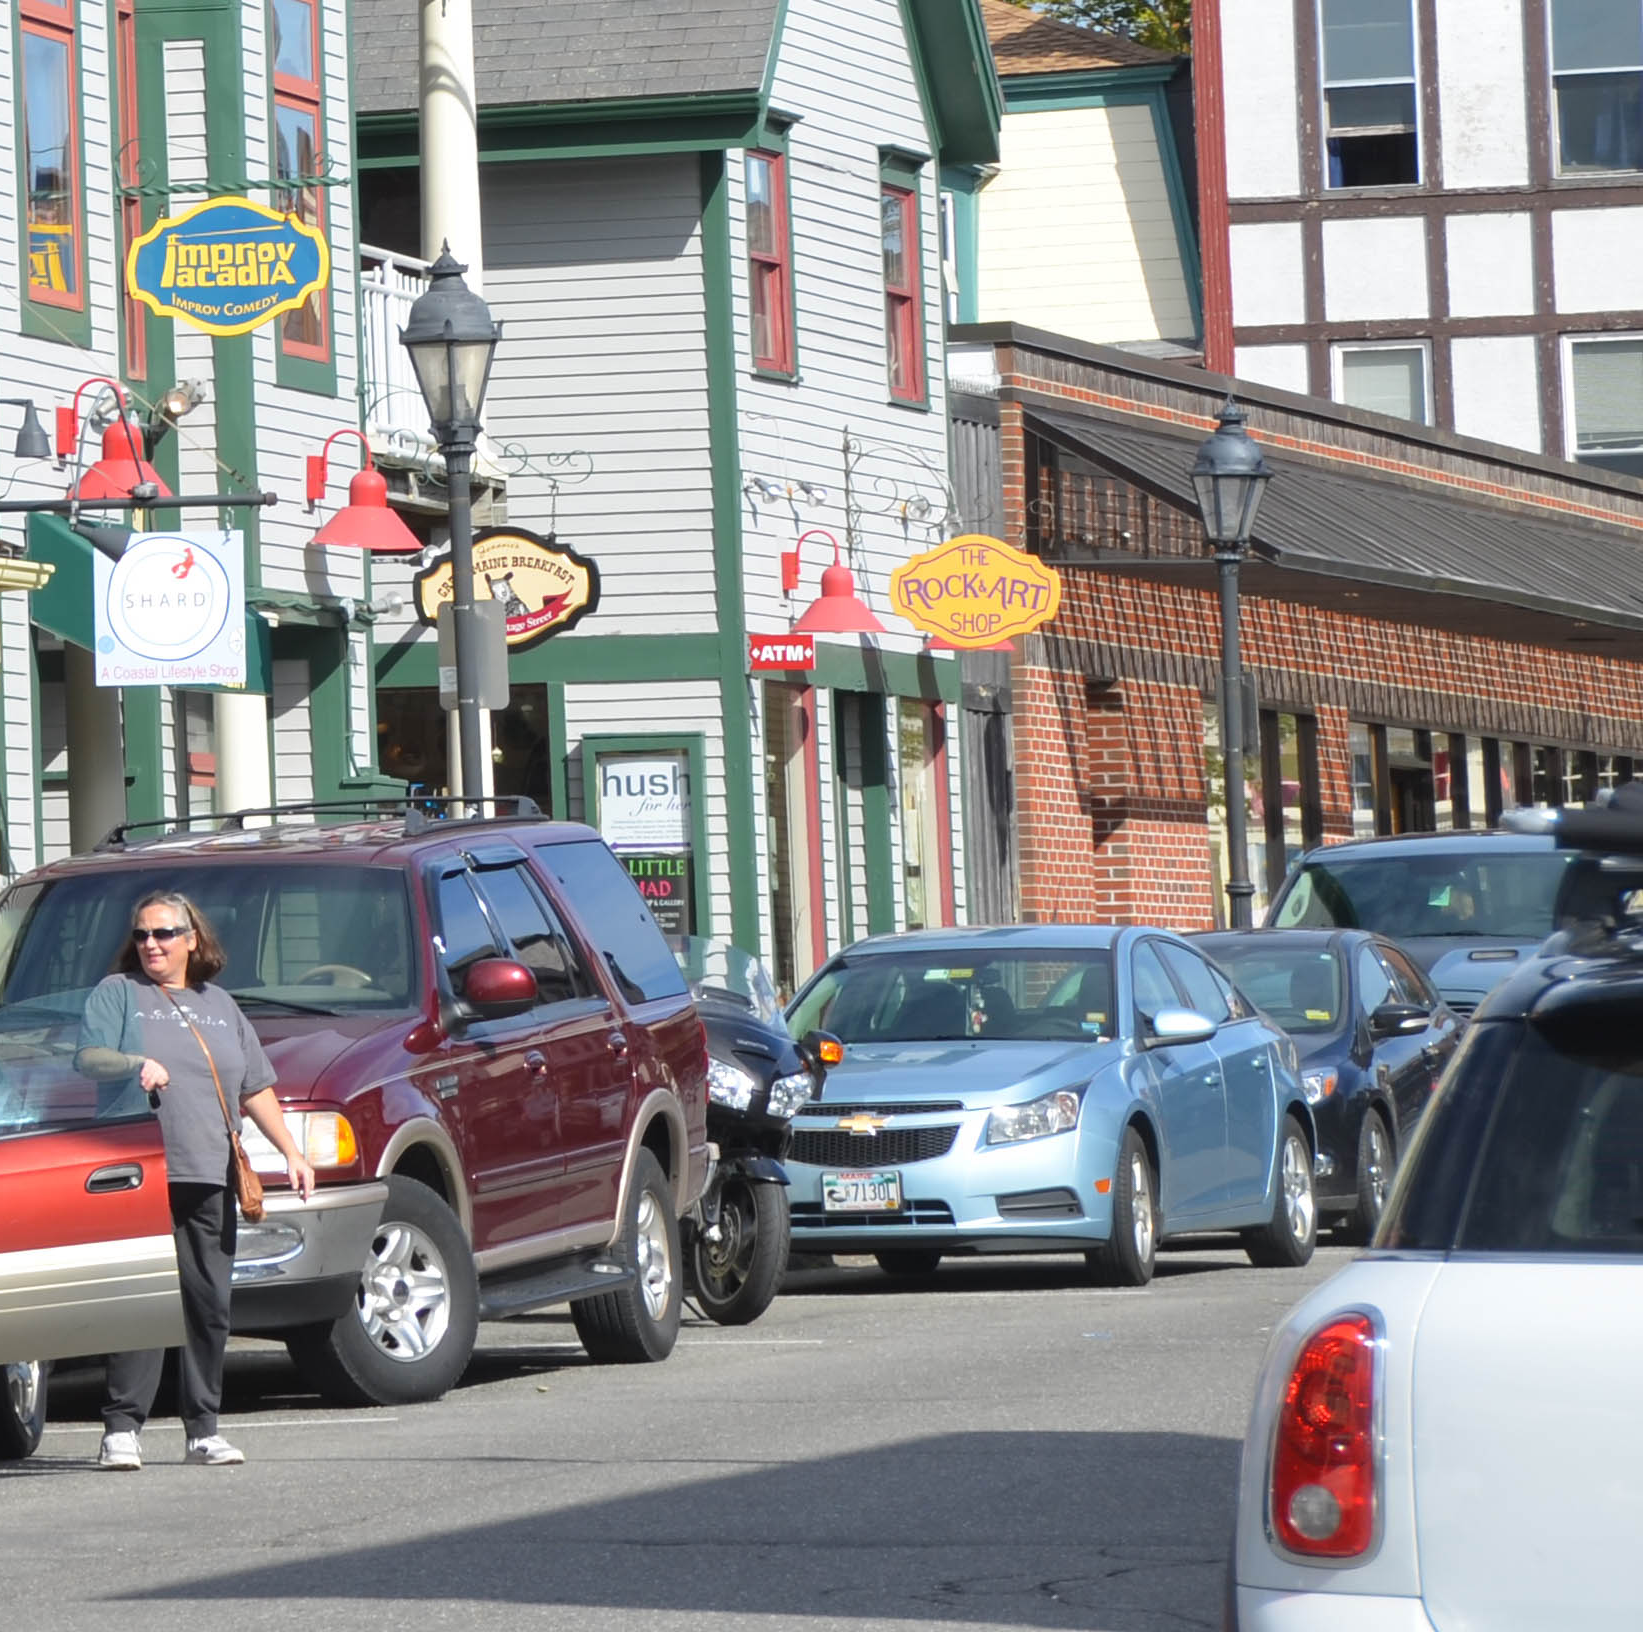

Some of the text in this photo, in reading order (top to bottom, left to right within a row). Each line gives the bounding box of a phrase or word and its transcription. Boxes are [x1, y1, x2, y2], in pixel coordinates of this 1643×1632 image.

[958, 548, 990, 567] THE
[472, 556, 509, 575] MAINE
[511, 556, 576, 585] BREAKFAST
[125, 592, 206, 609] SHARD
[902, 573, 980, 610] ROCK
[987, 575, 1048, 611] ART
[526, 610, 554, 628] Street
[950, 613, 1002, 633] SHOP
[760, 645, 804, 662] ATM
[101, 663, 239, 681] A Coastal Lifestyle Shop
[602, 764, 691, 797] hush
[629, 797, 663, 817] for
[628, 859, 686, 877] LITTLE
